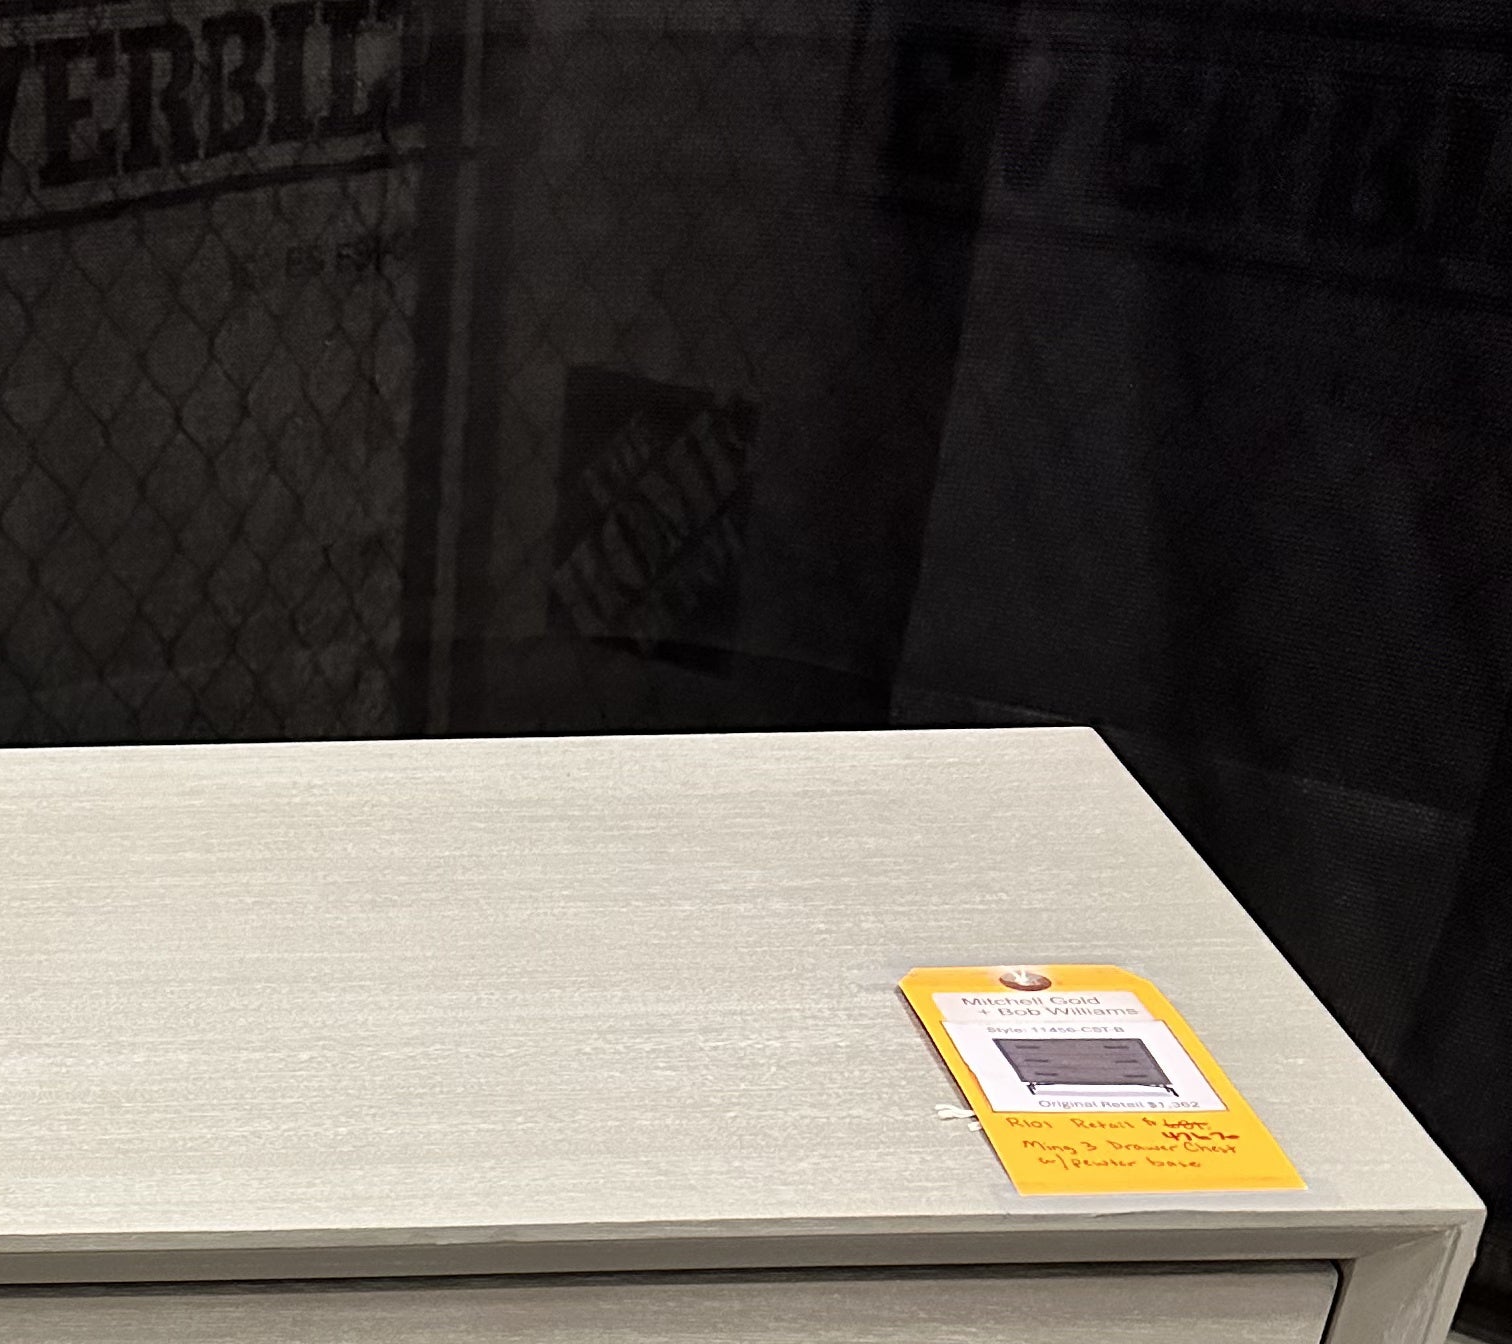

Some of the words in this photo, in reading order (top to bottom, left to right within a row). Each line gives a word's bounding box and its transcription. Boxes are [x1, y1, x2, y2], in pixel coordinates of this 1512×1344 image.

[961, 996, 1043, 1006] Mitchell
[1049, 996, 1101, 1006] Gold
[998, 1007, 1041, 1016] Bob
[1046, 1007, 1139, 1016] Williams
[1038, 1100, 1097, 1109] Original
[1101, 1100, 1144, 1108] Retail
[1070, 1117, 1135, 1129] Retail
[1081, 1141, 1096, 1151] 3
[1106, 1140, 1178, 1152] Drawer
[1184, 1141, 1237, 1153] Chest
